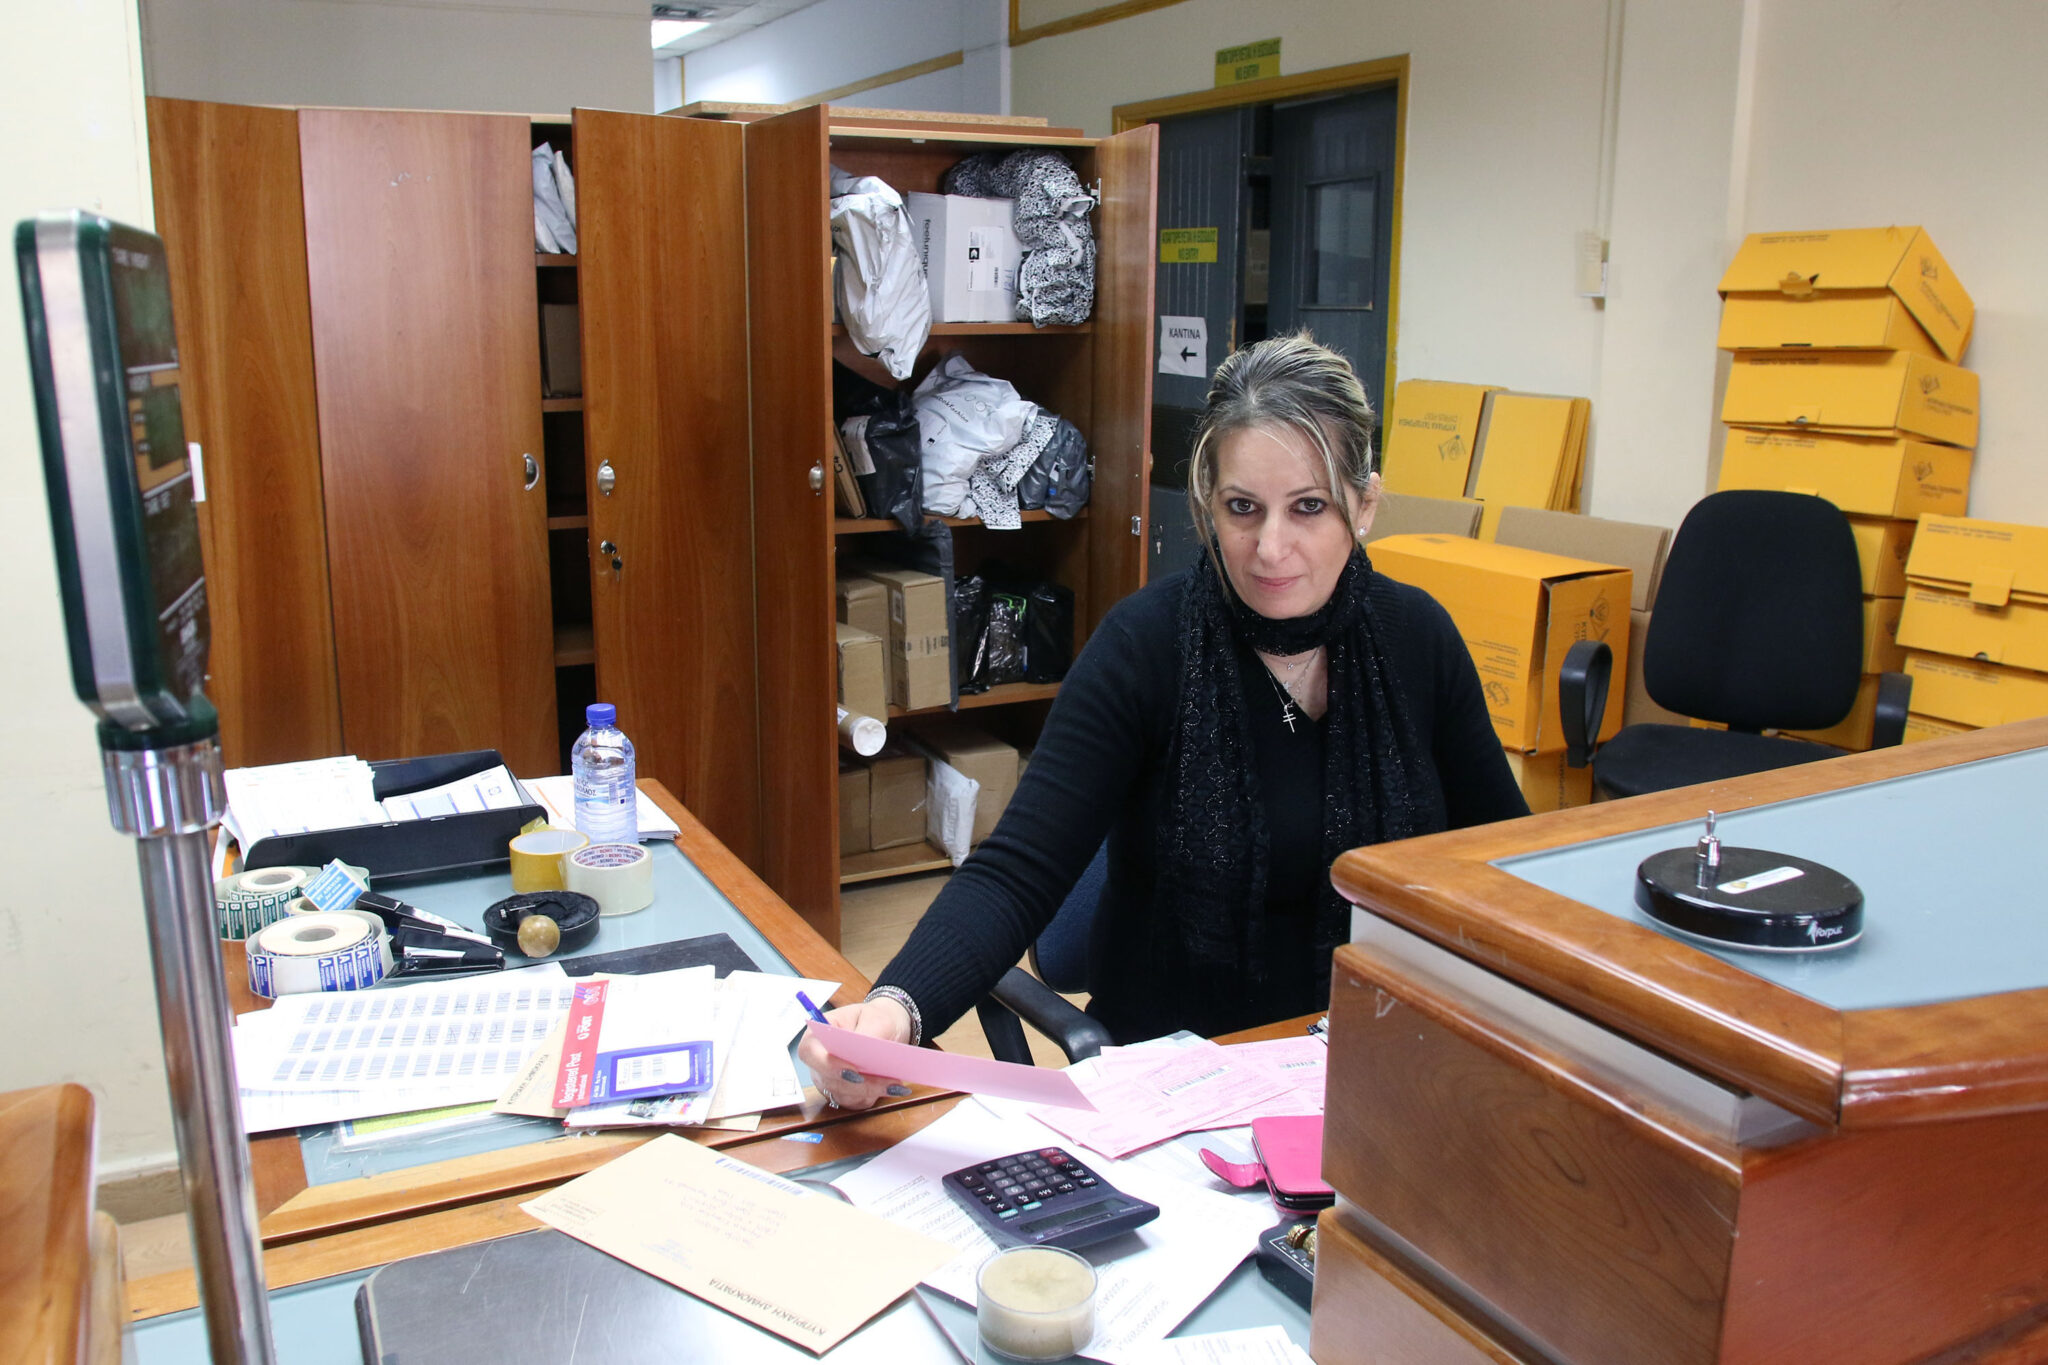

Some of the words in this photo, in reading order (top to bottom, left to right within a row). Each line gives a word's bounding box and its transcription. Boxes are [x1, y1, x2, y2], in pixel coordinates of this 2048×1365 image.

[320, 959, 332, 967] A
[339, 955, 350, 964] A
[357, 950, 367, 958] A
[559, 1068, 580, 1104] Registered
[709, 1278, 772, 1310] ΔΗΜΟΚΡΑΤΙΑ
[772, 1307, 826, 1336] ΚΥΠΡΙΑΚΗ
